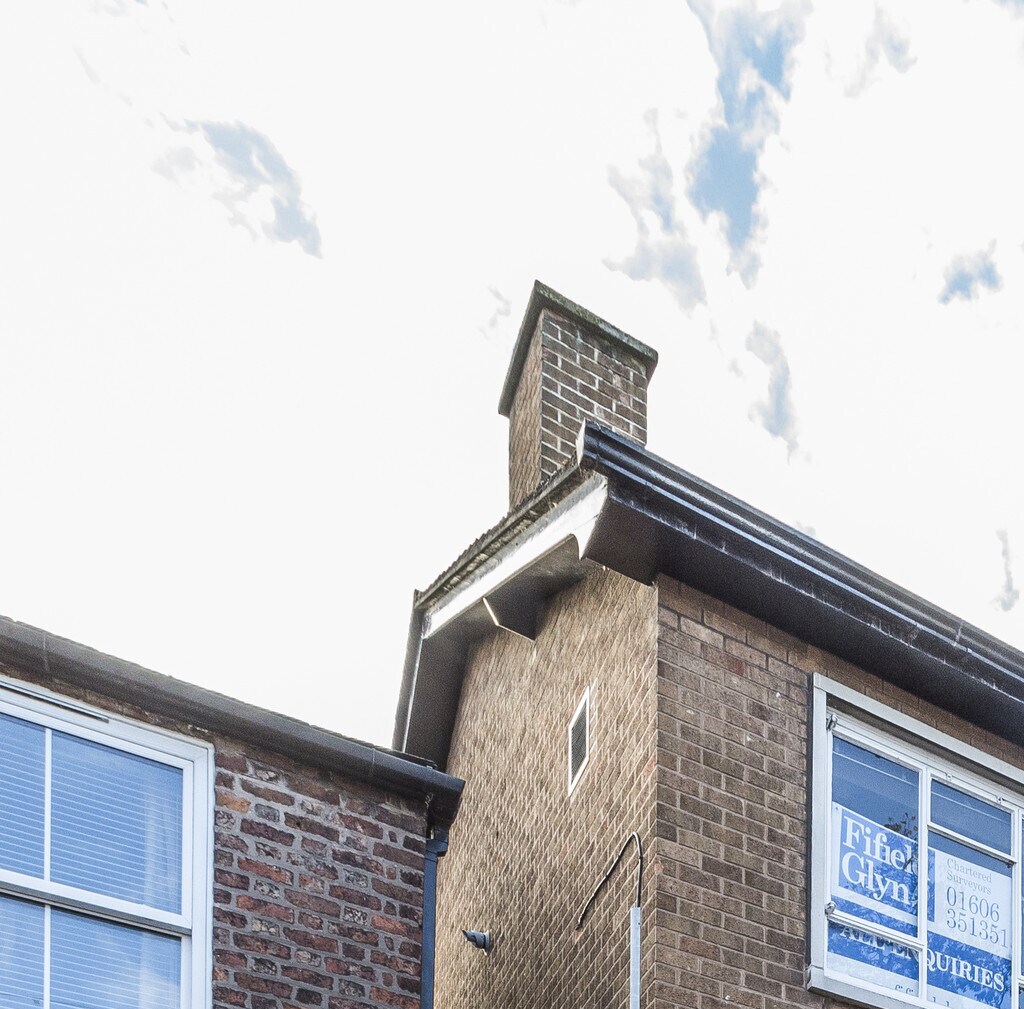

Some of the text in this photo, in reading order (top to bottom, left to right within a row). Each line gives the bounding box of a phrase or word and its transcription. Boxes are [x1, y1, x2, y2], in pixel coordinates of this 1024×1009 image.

[842, 852, 911, 905] Glyn
[946, 857, 992, 883] Chartered
[946, 870, 992, 895] Surveyors
[946, 886, 1000, 922] 01606
[946, 908, 1008, 948] 351351
